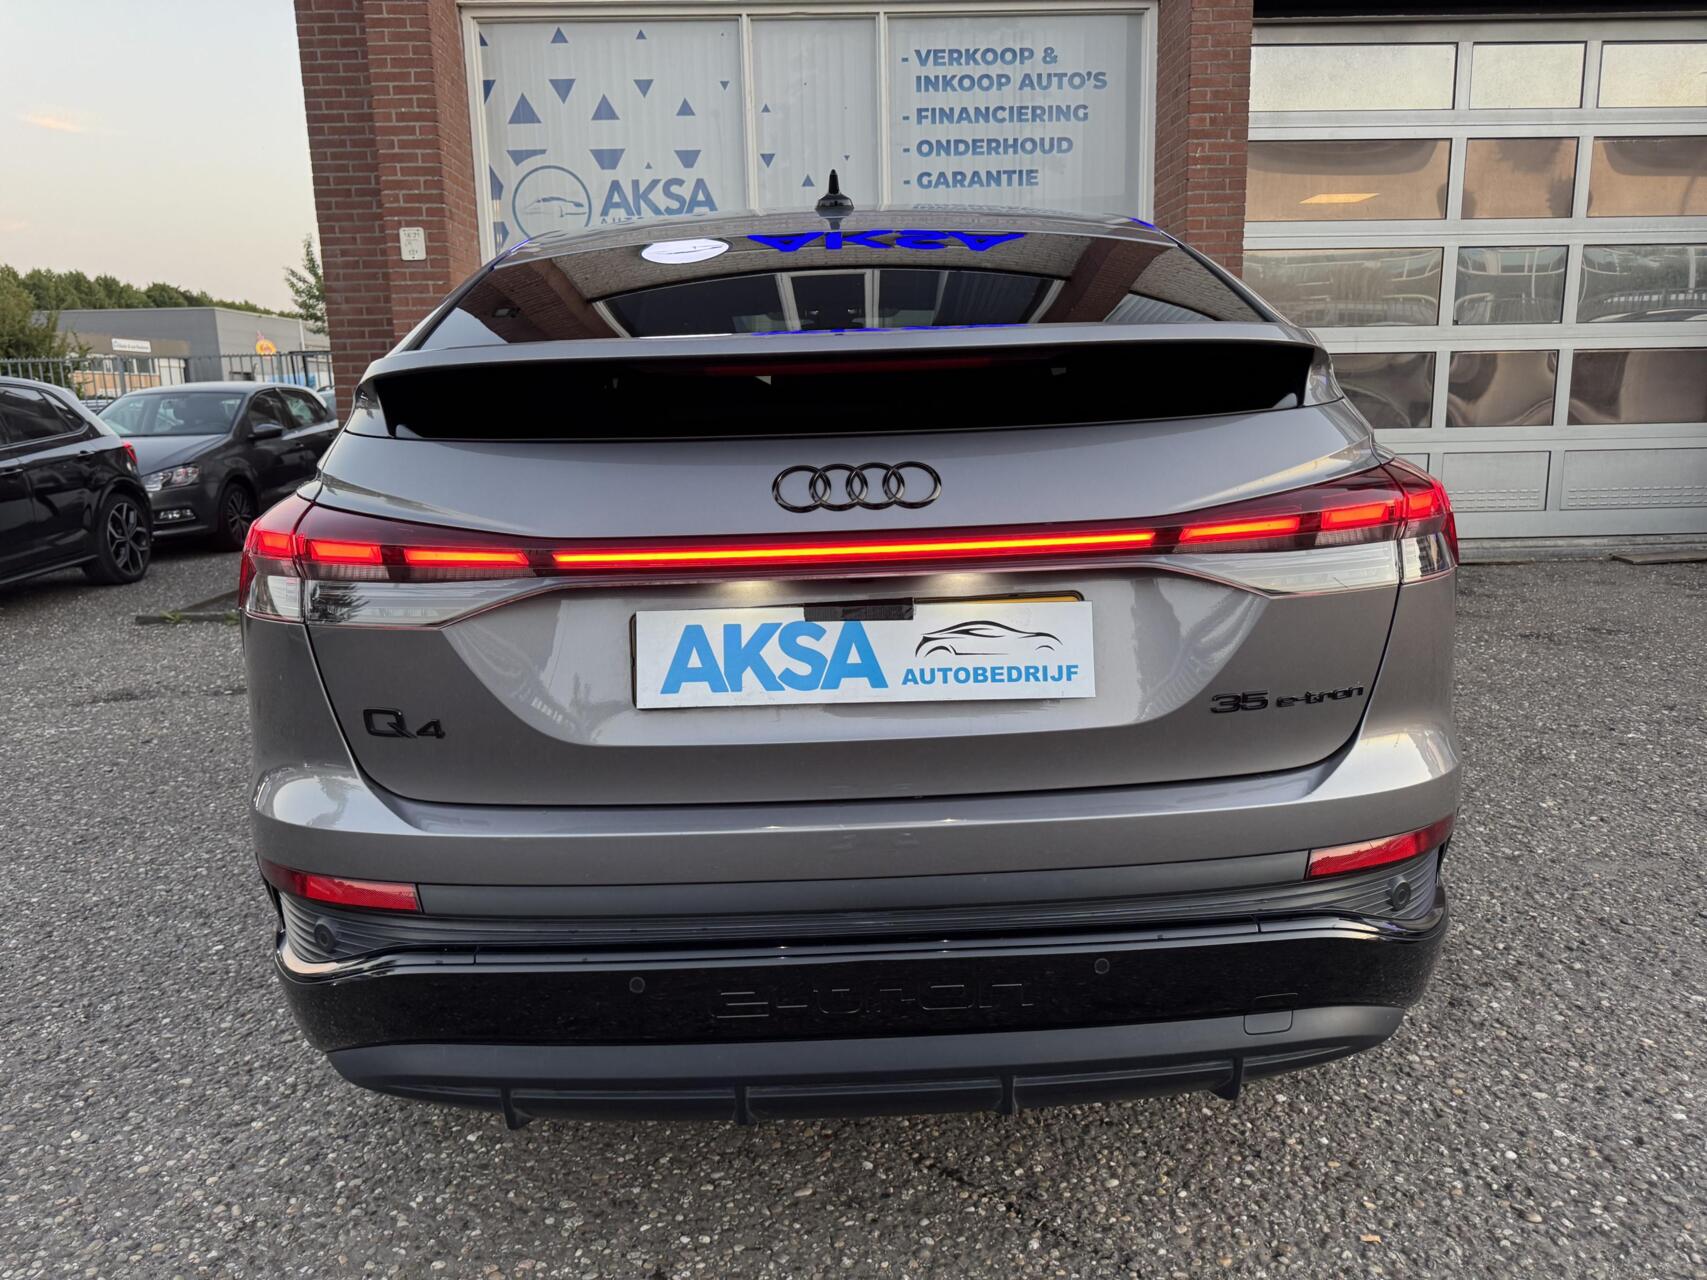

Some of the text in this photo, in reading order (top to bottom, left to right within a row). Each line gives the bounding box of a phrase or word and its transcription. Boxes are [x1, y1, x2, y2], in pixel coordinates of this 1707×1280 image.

[914, 47, 1034, 67] VERKOOP
[1042, 47, 1058, 65] &
[915, 71, 1108, 92] INKOOP AUTO'S
[916, 104, 1089, 125] FINANCIERING
[916, 136, 1073, 157] ONDERHOUD
[917, 169, 1039, 189] GARANTIE
[600, 178, 718, 217] AKSA
[660, 619, 1079, 694] AKSA AUTOBEDRIJF
[1211, 686, 1364, 714] 35 e-tron
[363, 708, 446, 739] Q4
